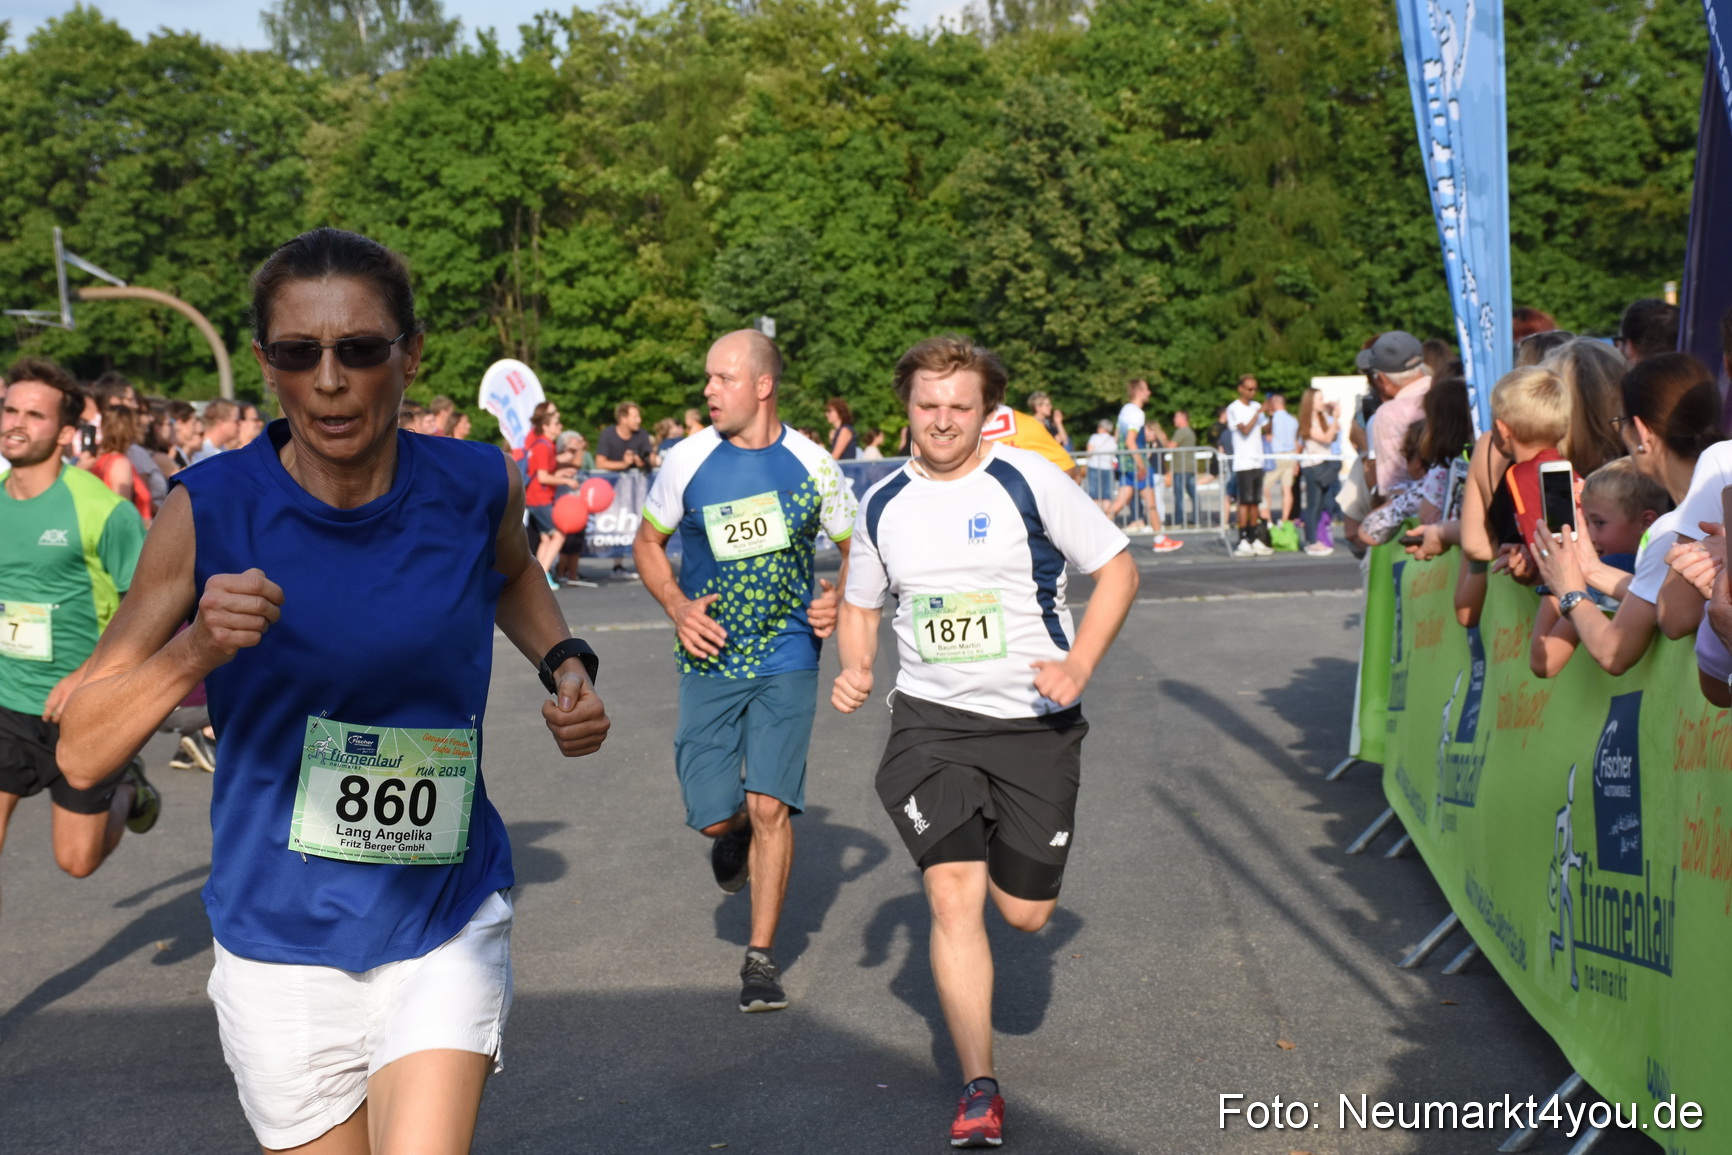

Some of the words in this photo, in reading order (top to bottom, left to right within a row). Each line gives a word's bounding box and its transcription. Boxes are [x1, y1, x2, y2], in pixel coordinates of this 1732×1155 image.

[585, 507, 638, 533] sch
[39, 528, 69, 543] AOK
[724, 517, 768, 544] 250
[8, 622, 19, 641] 7
[924, 615, 988, 643] 1871
[937, 644, 957, 652] Baum
[959, 642, 981, 650] Martin
[352, 737, 374, 745] Fischer
[329, 762, 361, 771] neumarkt
[330, 748, 404, 768] firmenlauf
[1600, 747, 1632, 778] Fischer
[438, 766, 467, 777] 2019
[336, 775, 437, 827] 860
[336, 824, 371, 841] Lang
[375, 828, 432, 843] Angelika
[914, 820, 930, 835] LFC
[340, 839, 361, 849] Fritz
[364, 841, 396, 852] Berger
[398, 843, 425, 852] GmbH
[1584, 962, 1628, 1002] neumarkt
